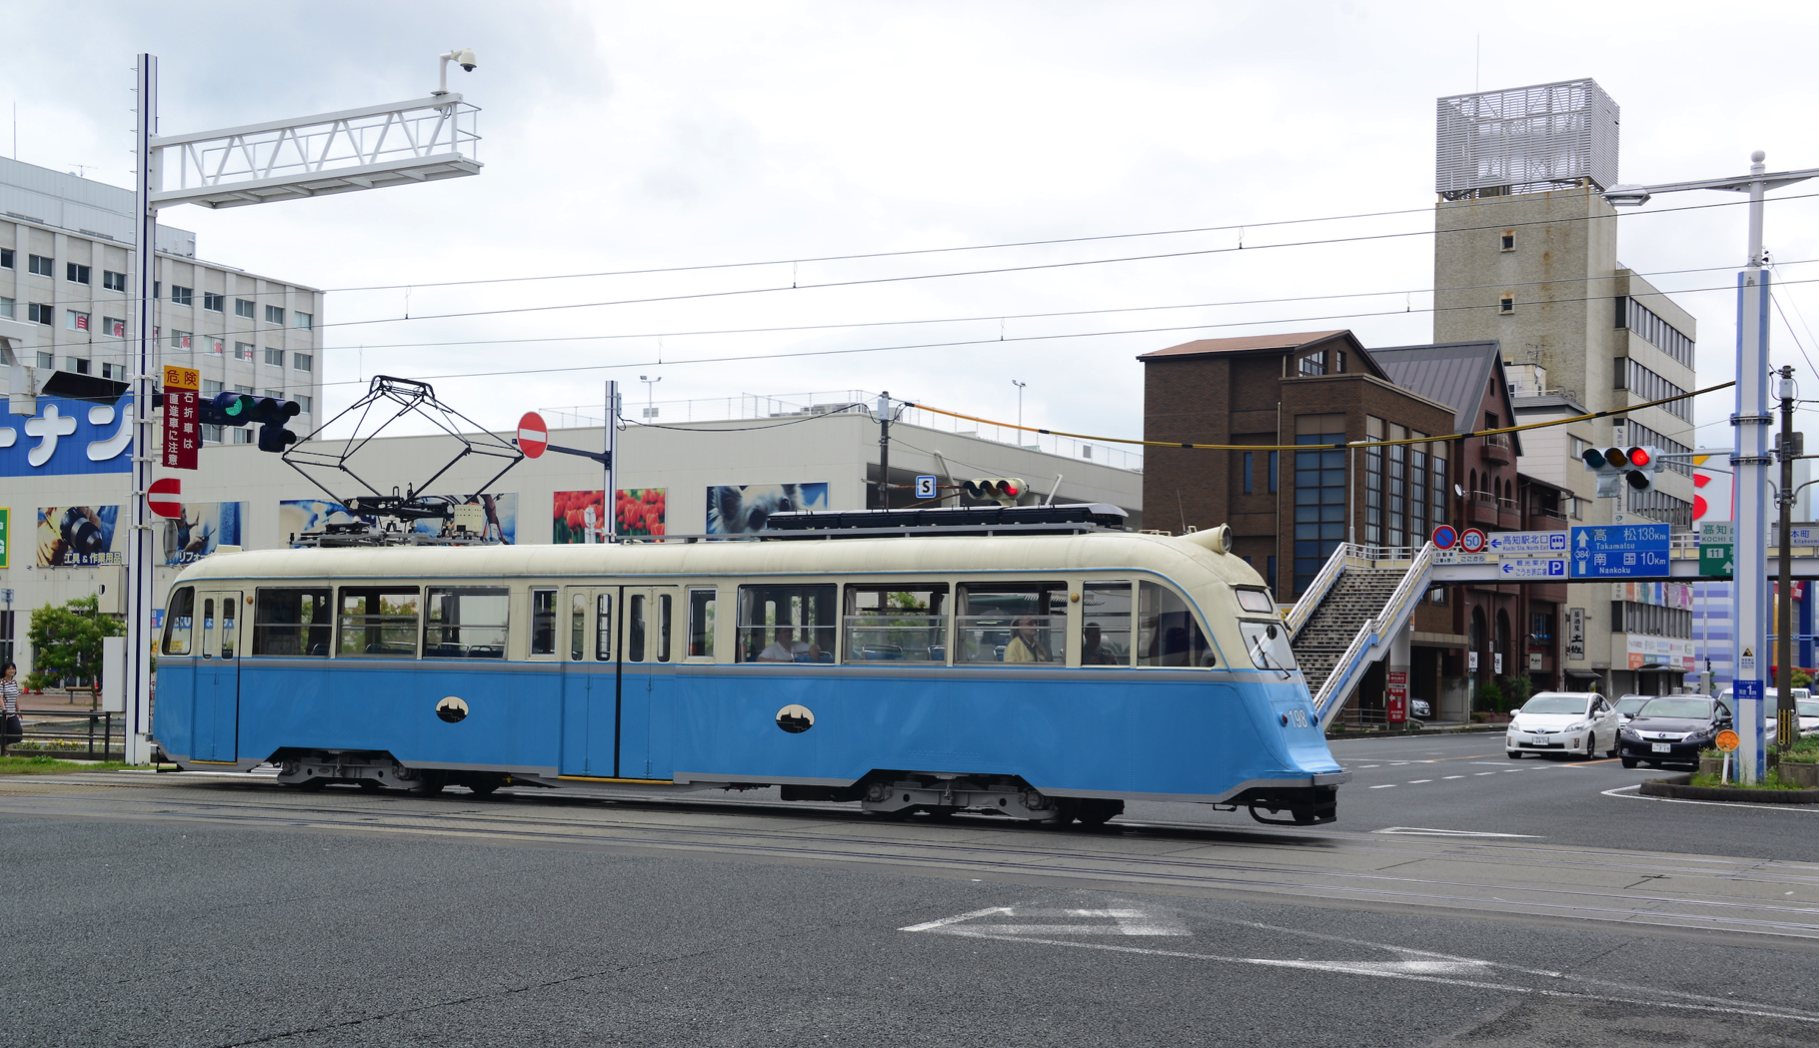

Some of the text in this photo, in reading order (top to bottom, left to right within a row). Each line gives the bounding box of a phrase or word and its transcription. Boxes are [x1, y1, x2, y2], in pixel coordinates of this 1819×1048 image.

[166, 369, 198, 387] 危険
[183, 391, 194, 449] 右折車は
[168, 393, 179, 466] 直進車に注意
[922, 480, 931, 493] S
[1502, 534, 1549, 545] 高知駅北口
[1593, 528, 1637, 542] 高松
[1790, 530, 1810, 539] 本町
[1465, 535, 1480, 547] 50
[1595, 542, 1636, 550] Takamatsu
[64, 552, 80, 565] 工具
[89, 551, 123, 564] 作業用品
[1575, 550, 1589, 559] 384
[1593, 551, 1667, 566] 南国 10Km
[1709, 549, 1720, 558] 11
[1516, 559, 1547, 567] 観光案内
[1599, 566, 1631, 574] Nankoku
[1288, 709, 1308, 728] 198
